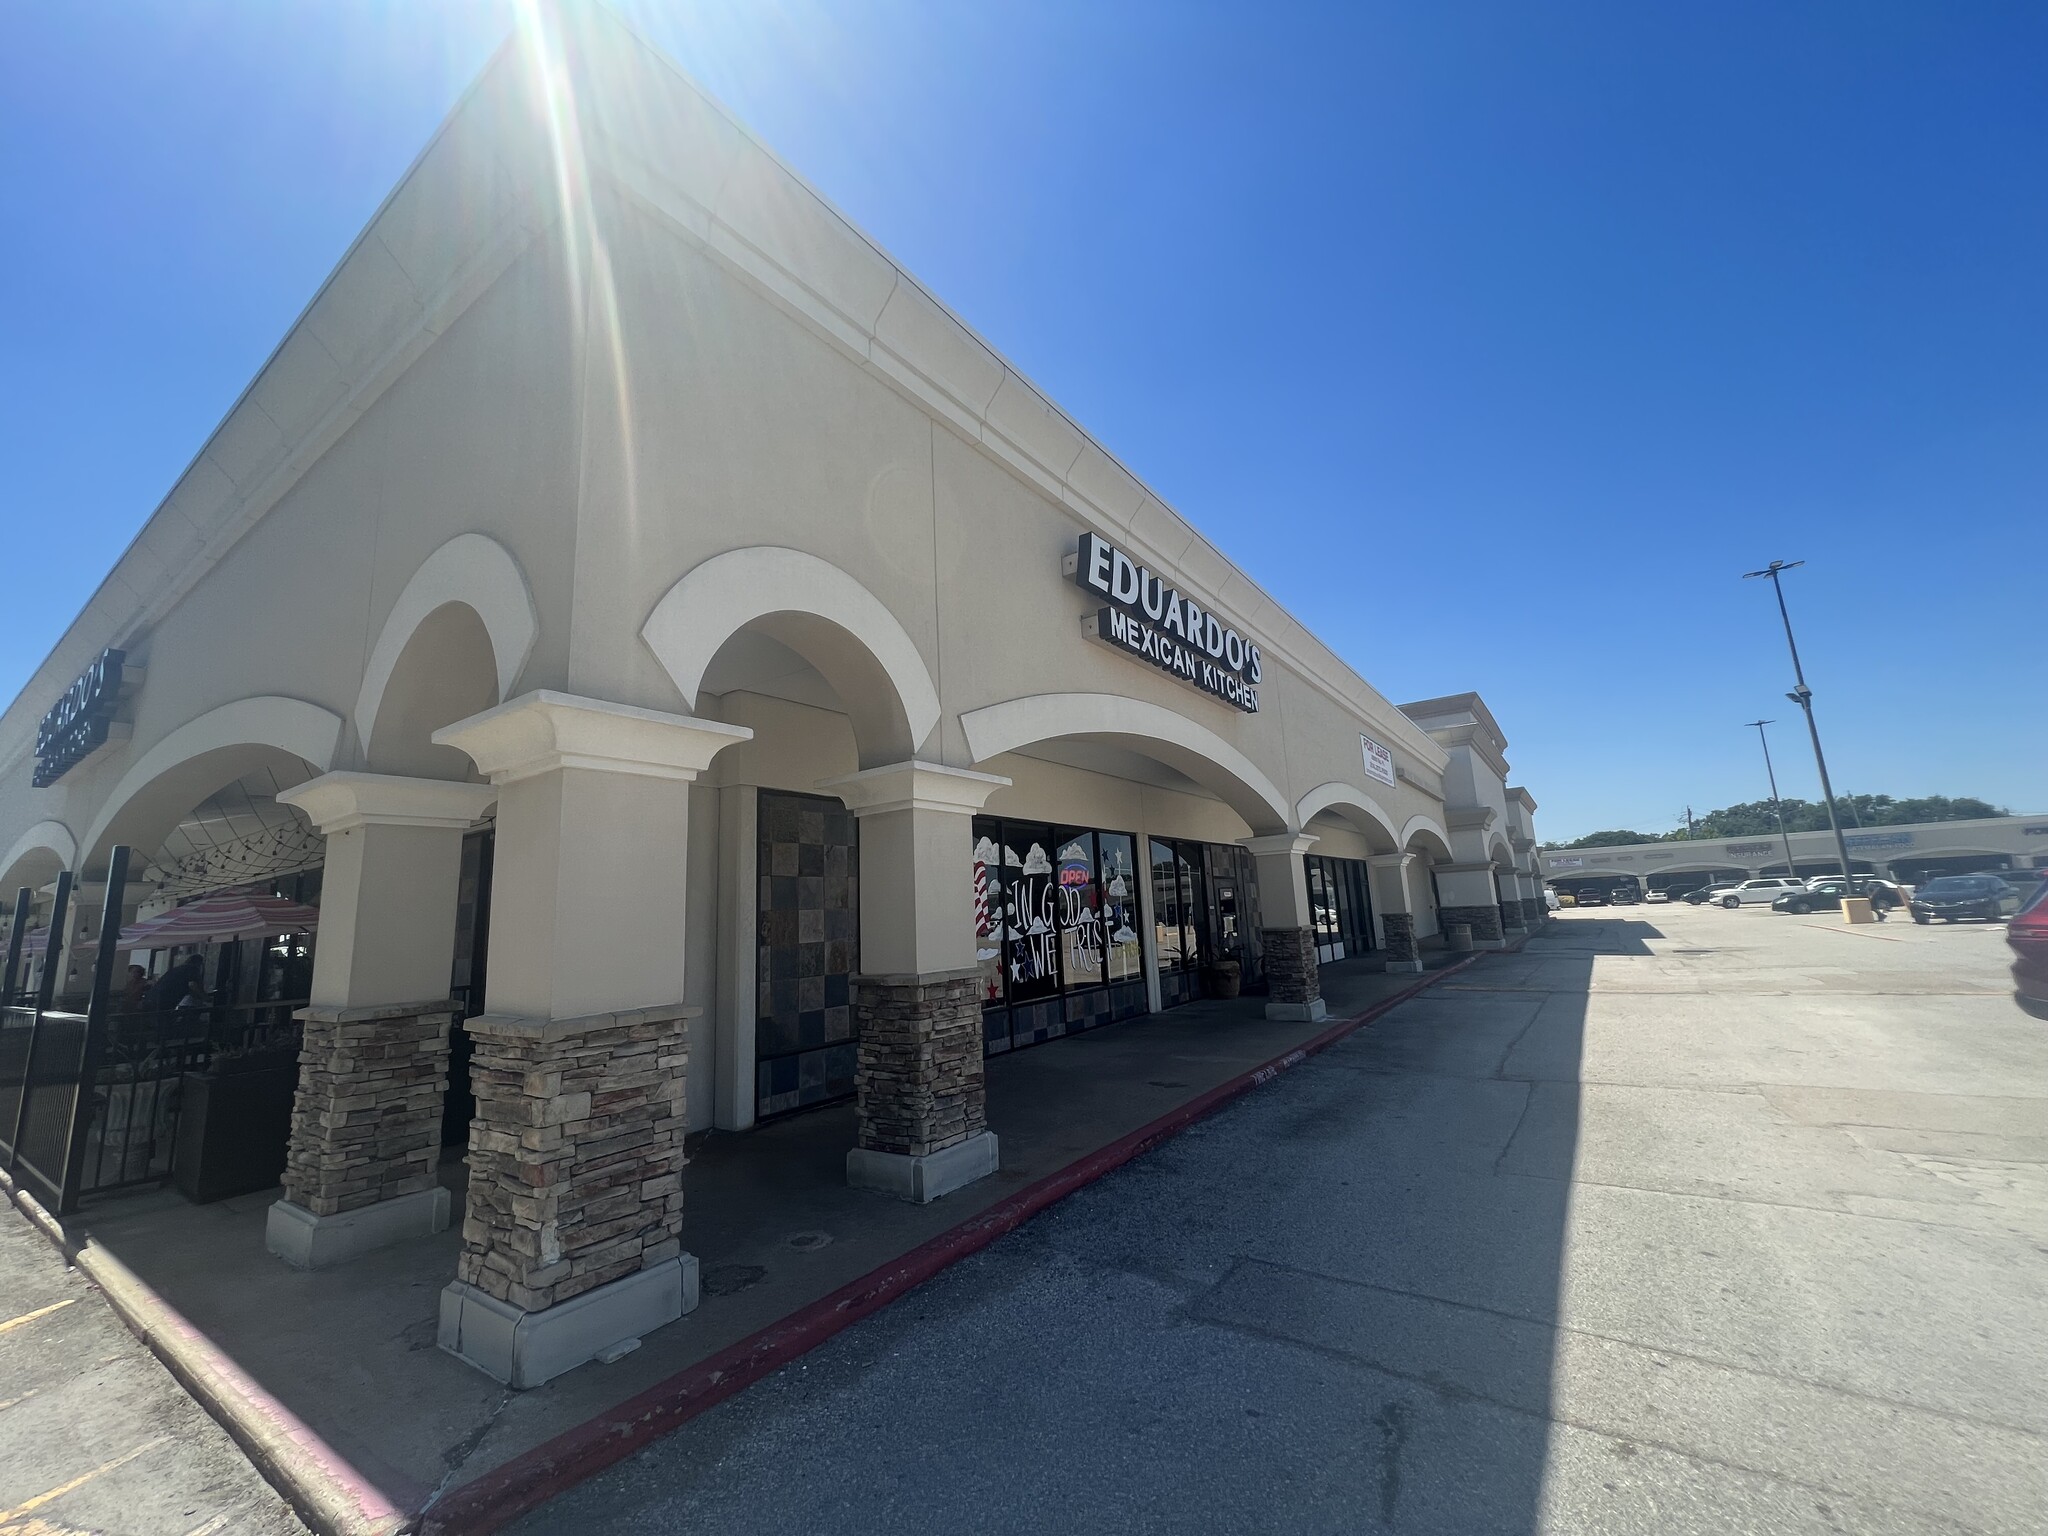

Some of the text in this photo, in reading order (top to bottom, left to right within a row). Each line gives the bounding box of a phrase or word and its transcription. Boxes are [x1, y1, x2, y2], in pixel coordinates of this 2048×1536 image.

[1088, 532, 1263, 685] EDUARDO'S
[1110, 607, 1260, 713] MEXICAN KITCHEN
[1362, 737, 1375, 754] FOR
[1375, 745, 1390, 763] LEASE
[1059, 868, 1090, 886] OPEN
[1729, 850, 1774, 859] INSURANCE
[1012, 877, 1081, 933] IN GOD
[1030, 933, 1058, 980] WE
[1065, 919, 1114, 973] TRUST
